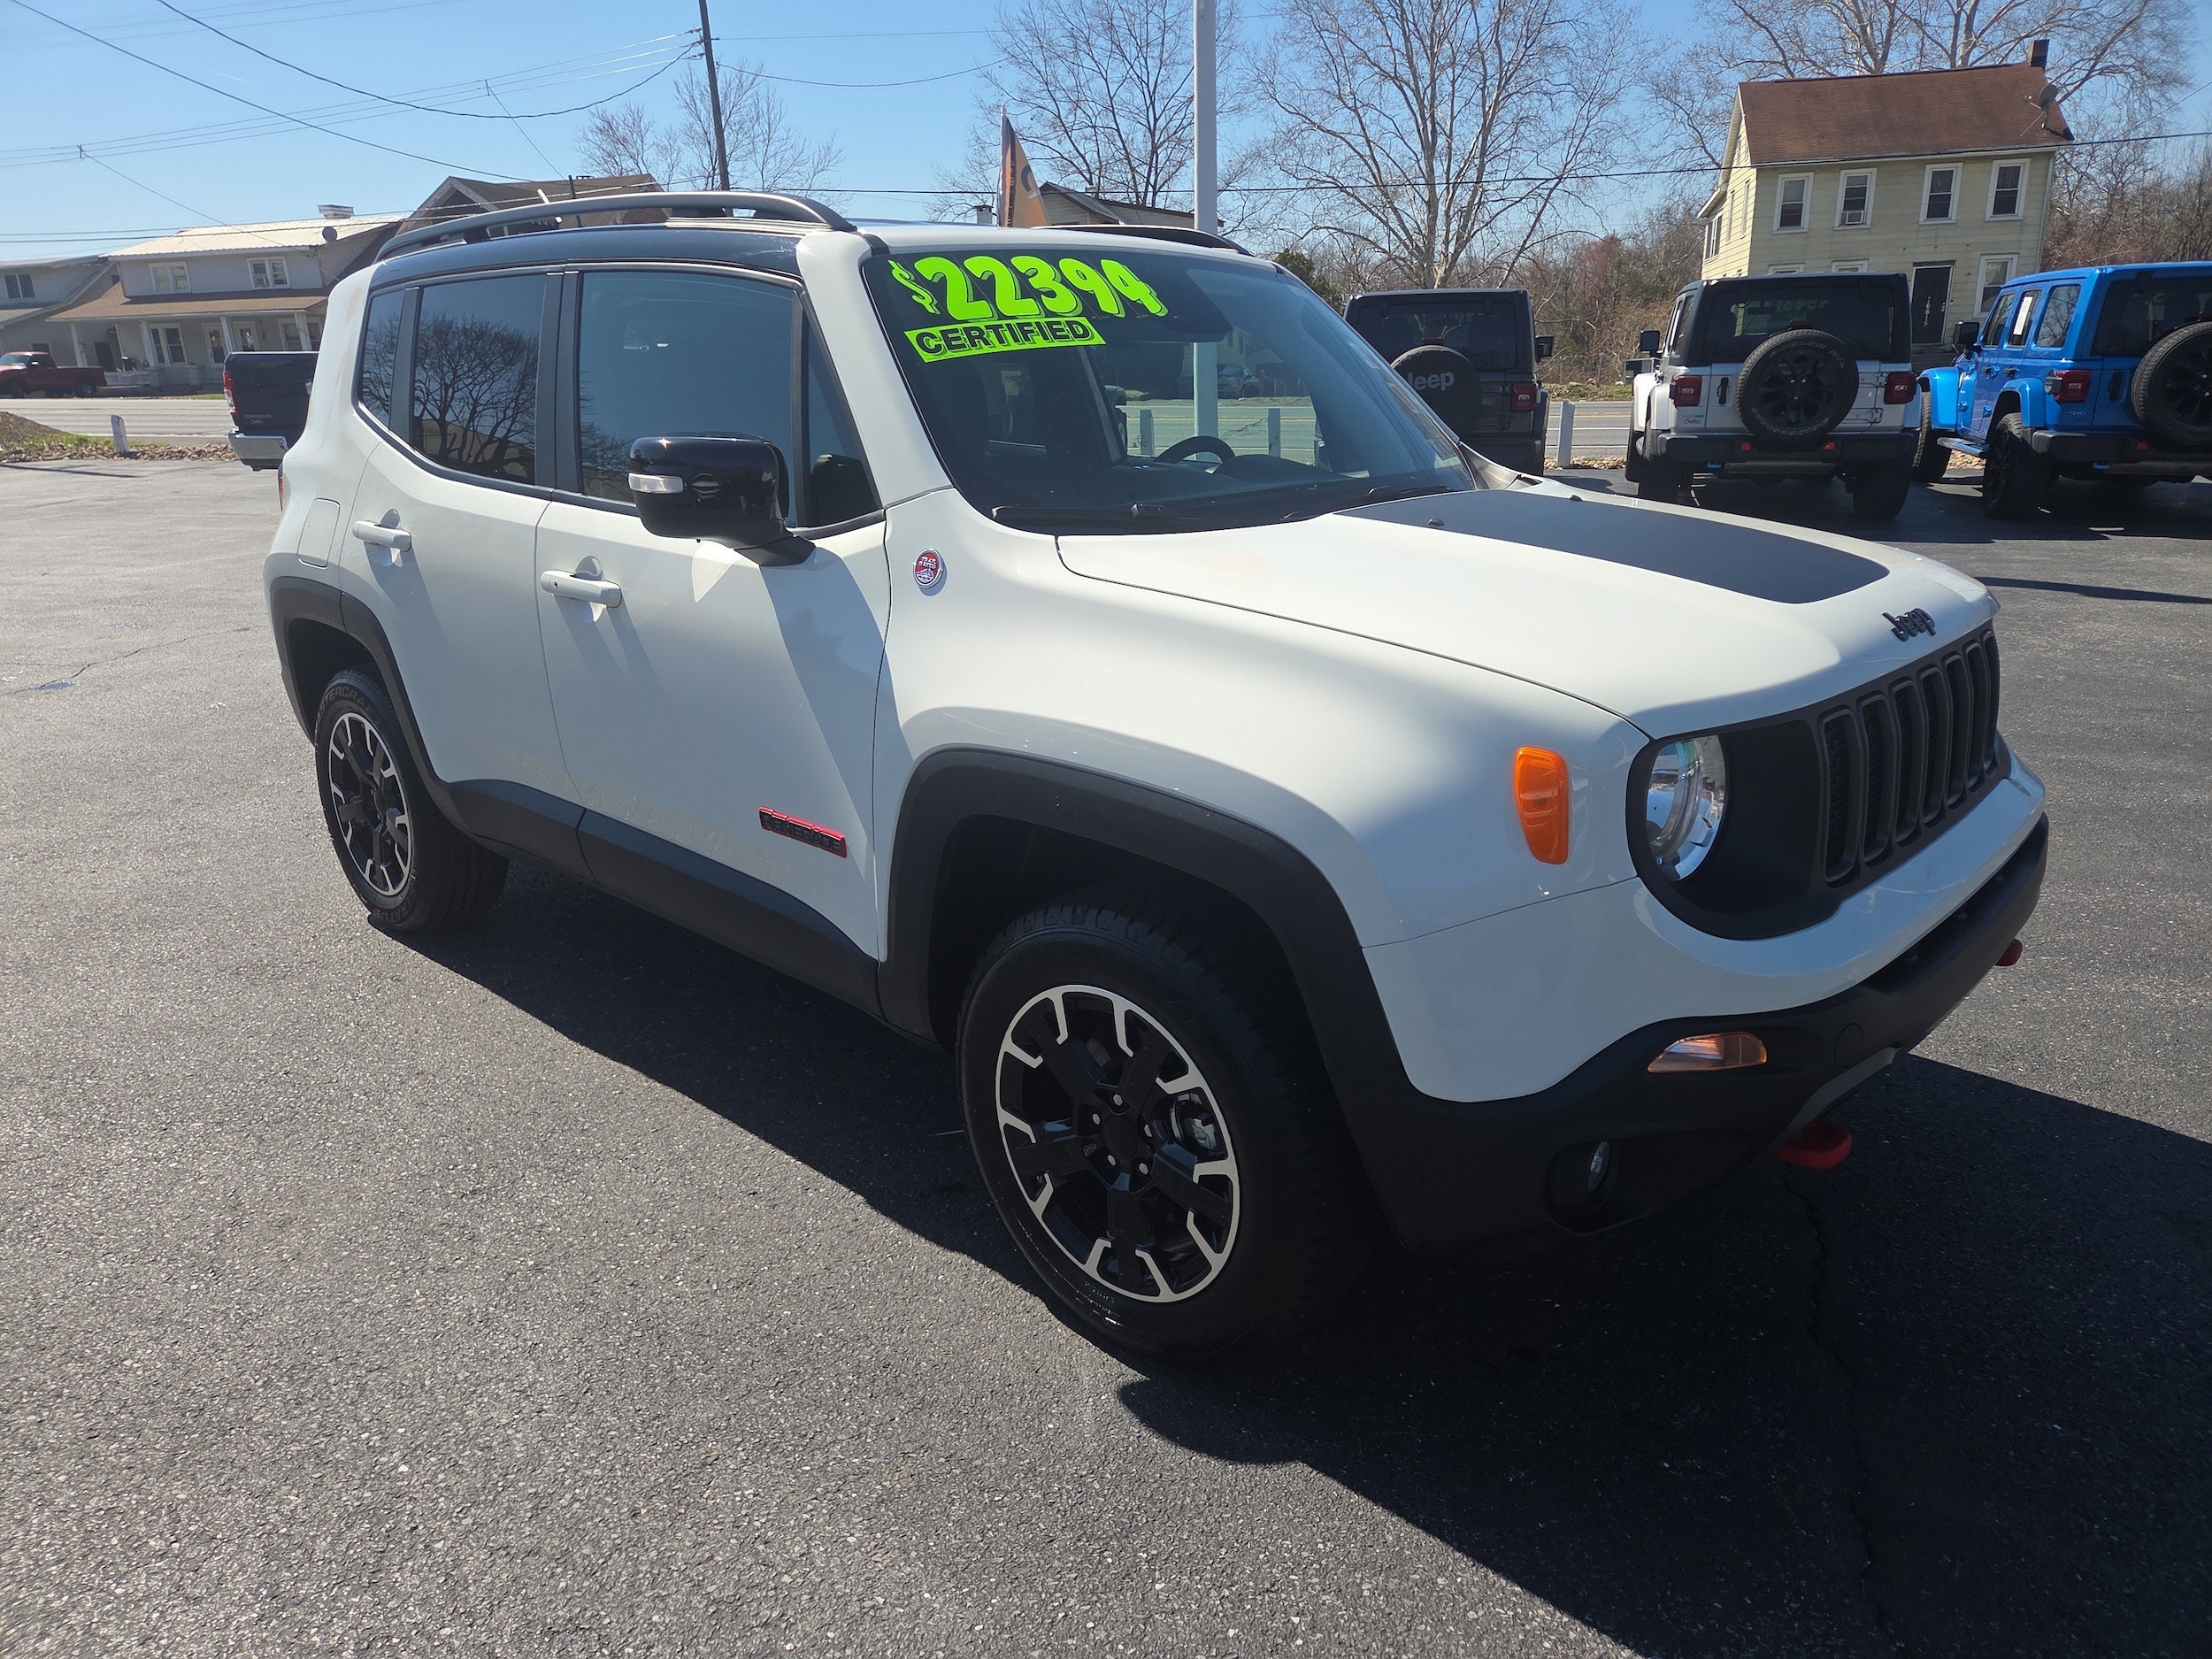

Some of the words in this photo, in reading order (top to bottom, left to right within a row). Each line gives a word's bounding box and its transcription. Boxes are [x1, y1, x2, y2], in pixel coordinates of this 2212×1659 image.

[887, 255, 1168, 320] $22394
[915, 319, 1094, 357] CERTIFIED
[1881, 608, 1936, 642] Jeep
[760, 809, 844, 856] RENEGADE
